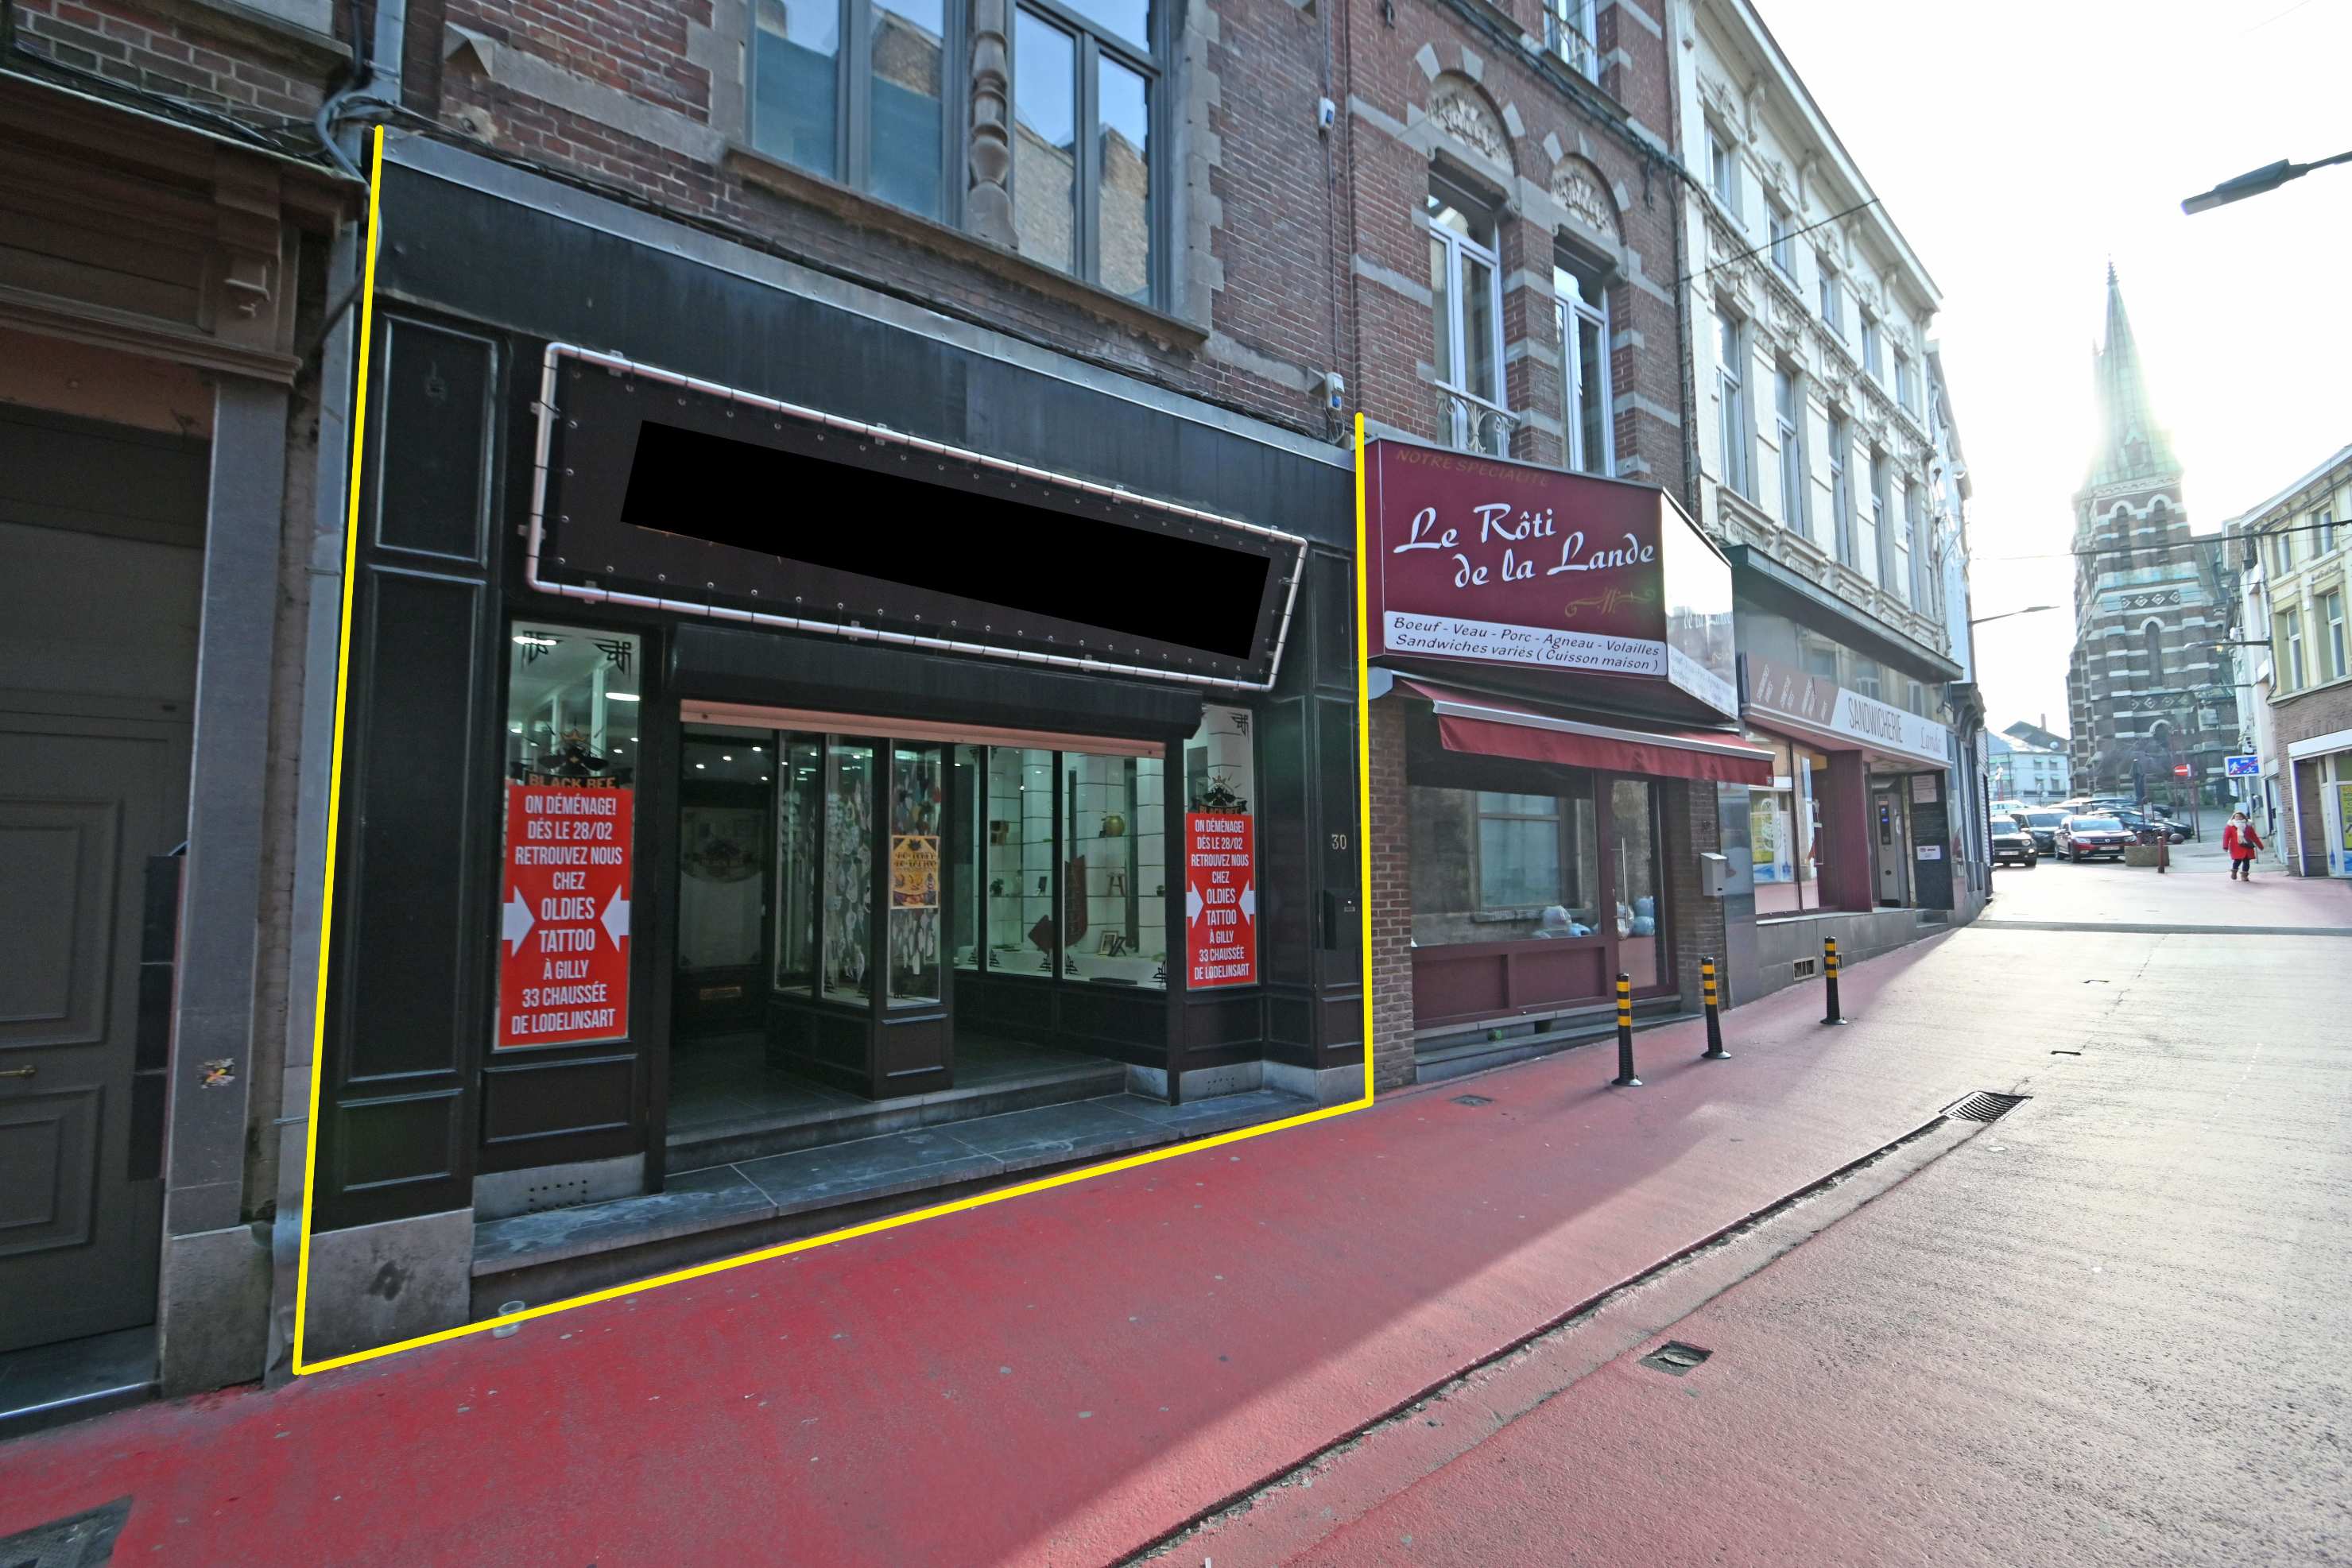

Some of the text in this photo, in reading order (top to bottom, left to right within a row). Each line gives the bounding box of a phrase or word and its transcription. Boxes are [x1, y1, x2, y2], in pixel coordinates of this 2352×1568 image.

[1397, 449, 1451, 470] NOTRE
[1393, 502, 1557, 554] Le Rôti
[1451, 531, 1656, 588] de la Lande
[1393, 617, 1443, 633] Boeuf
[1454, 623, 1488, 638] Veau
[1501, 629, 1532, 642] Porc
[1542, 633, 1594, 650] Agneau
[1606, 640, 1660, 656] Volailles
[1396, 633, 1489, 654] Sandwiches
[1491, 645, 1534, 659] variés
[1546, 648, 1598, 665] Cuisson
[1602, 657, 1649, 670] maison
[1848, 697, 1903, 743] SANDWICHERIE
[529, 772, 616, 788] BLACK BEE
[525, 792, 617, 815] ON DÉMÉNAGE!
[555, 822, 570, 840] LE
[573, 822, 613, 840] 28/02
[1195, 818, 1245, 833] ON DÉMÉNAGE!
[1211, 837, 1220, 850] LE
[1221, 838, 1243, 850] 28/02
[1331, 834, 1347, 850] 30
[514, 846, 622, 865] RETROUVEZ NOUS
[1191, 854, 1249, 867] RETROUVEZ NOUS
[552, 871, 586, 891] CHEZ
[1212, 871, 1230, 884] CHEZ
[1207, 888, 1236, 904] OLDIES
[541, 897, 595, 921] OLDIES
[1206, 909, 1237, 926] TATTOO
[538, 928, 595, 953] TATTOO
[1210, 929, 1234, 944] À GILLY
[1199, 944, 1245, 962] 33 CHAUSSÉE
[543, 958, 589, 980] À GILLY
[1195, 963, 1250, 980] DE LODELINSART
[522, 981, 606, 1008] 33 CHAUSSÉE
[511, 1009, 616, 1035] DE LODELINSART
